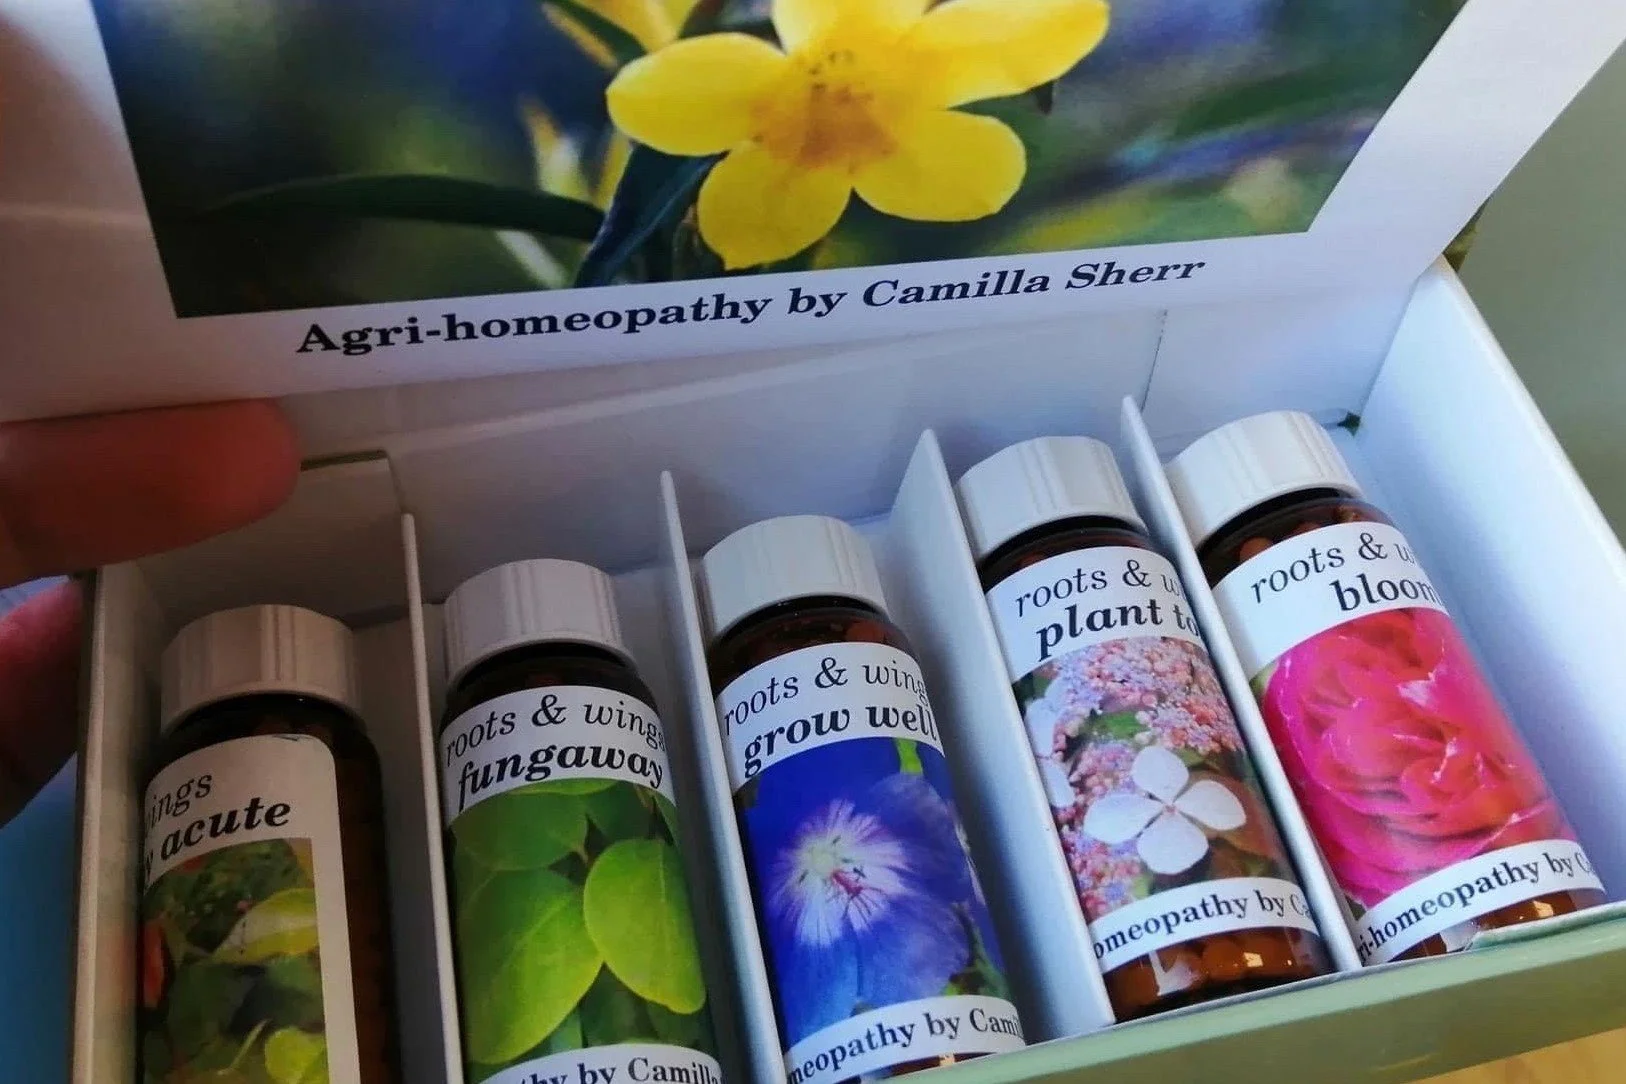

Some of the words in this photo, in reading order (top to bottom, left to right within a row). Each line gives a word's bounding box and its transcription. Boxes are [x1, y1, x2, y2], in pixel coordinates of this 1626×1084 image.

[296, 293, 772, 356] Agri-homeopathy
[788, 287, 848, 317] by
[862, 269, 1051, 307] Camilla
[1064, 259, 1206, 291] Sherr
[1015, 568, 1108, 617] roots
[1122, 559, 1152, 587] &
[1251, 546, 1345, 603] roots
[1358, 532, 1388, 561] &
[1329, 573, 1444, 611] bloom
[1036, 599, 1163, 662] plant
[723, 675, 799, 736] roots
[814, 657, 848, 689] &
[446, 711, 517, 767] roots
[531, 694, 567, 727] &
[584, 700, 666, 752] wings
[744, 707, 850, 779] grow
[865, 703, 937, 742] well
[146, 774, 213, 832] ings
[458, 744, 664, 812] fungaway
[161, 797, 292, 861] acute
[1544, 853, 1574, 877] by
[1093, 893, 1249, 958] omeopathy
[1254, 889, 1286, 917] by
[923, 1012, 961, 1040] by
[577, 1063, 617, 1084] by
